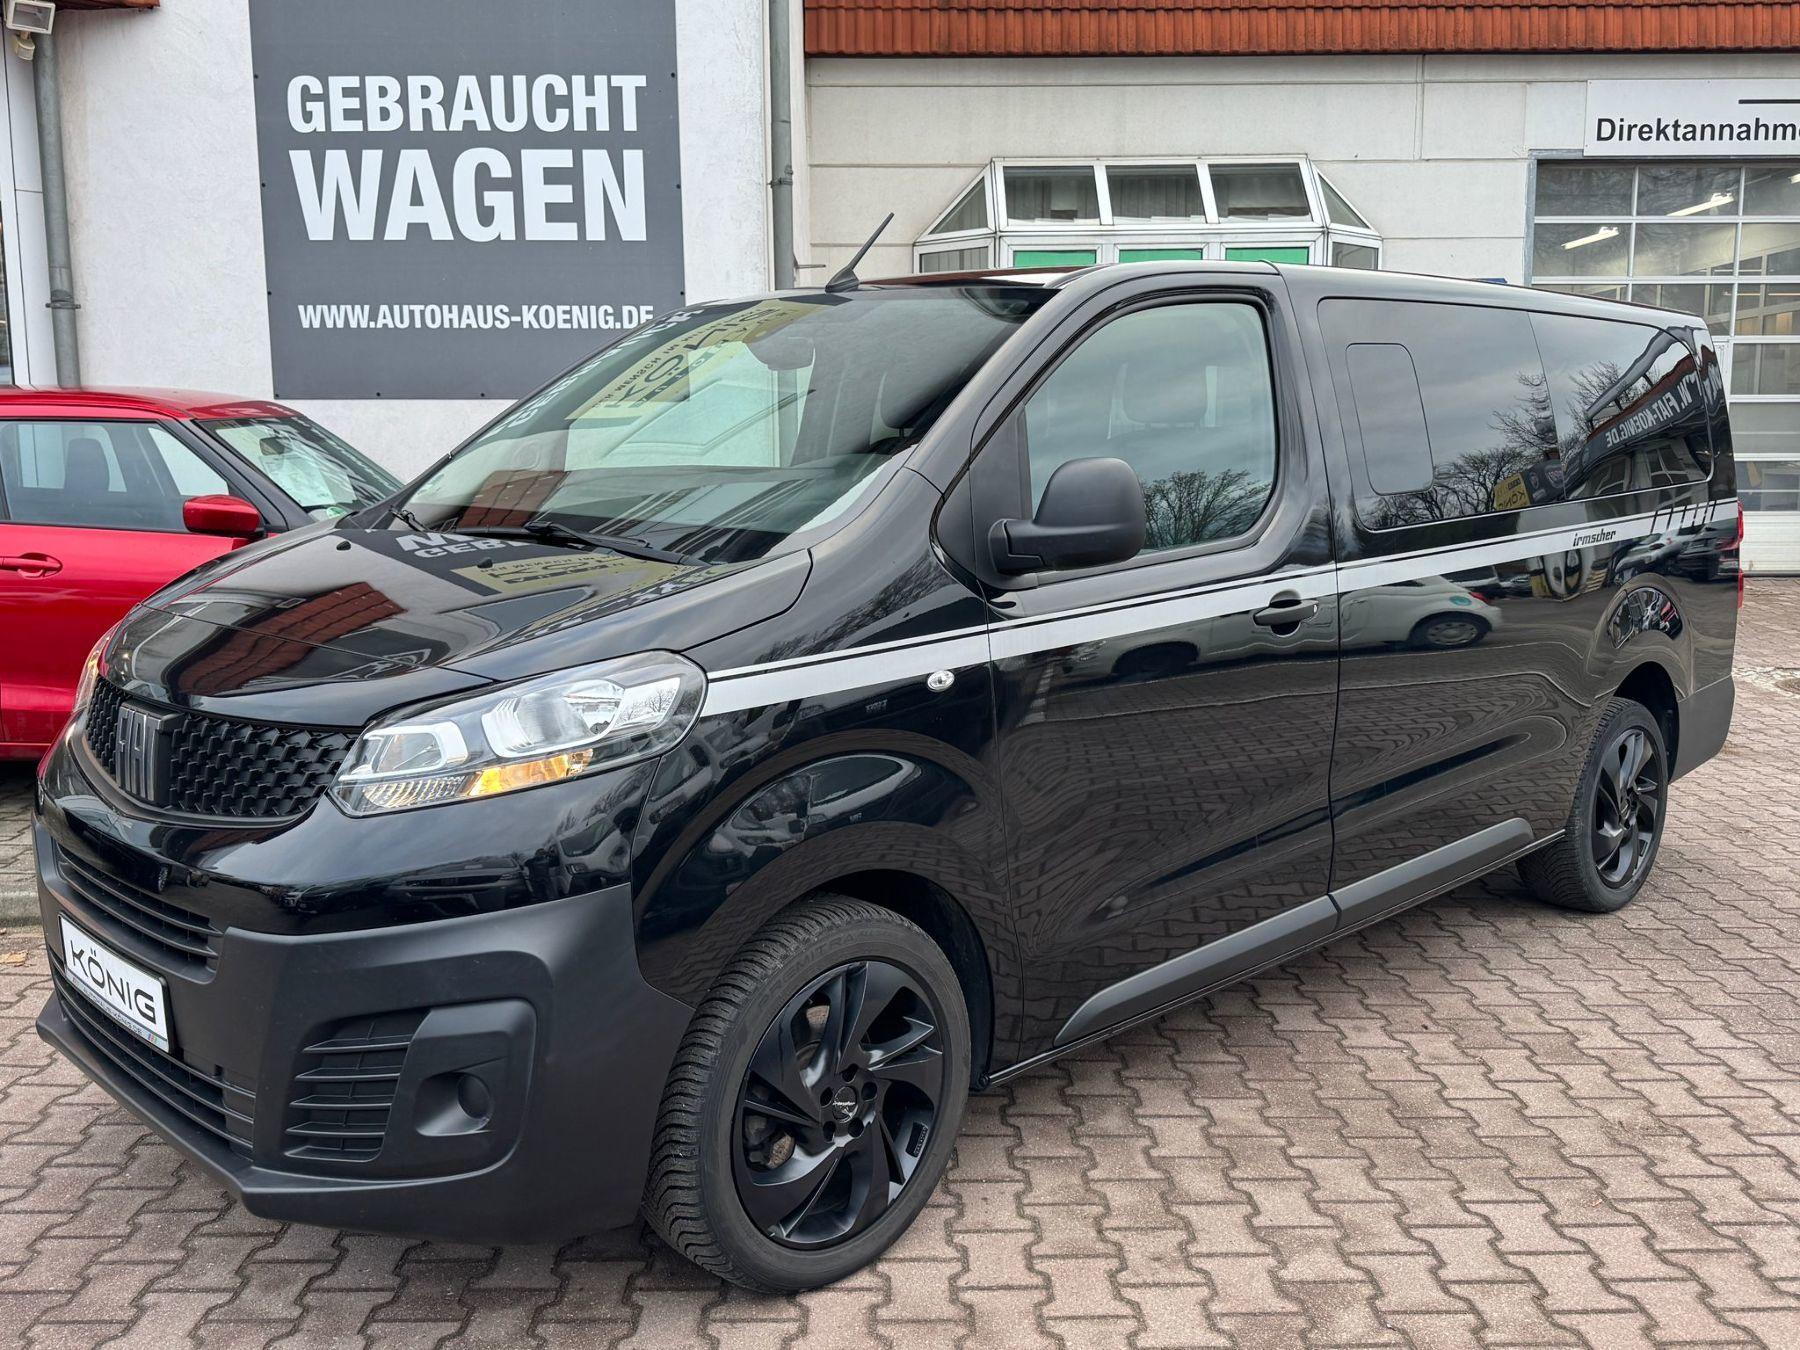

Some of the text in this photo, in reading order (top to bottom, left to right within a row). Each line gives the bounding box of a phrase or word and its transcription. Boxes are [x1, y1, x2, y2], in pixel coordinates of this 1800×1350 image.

[286, 74, 647, 133] GEBRAUCHT
[1596, 117, 1800, 142] Direktannahm
[288, 147, 648, 242] WAGEN
[297, 303, 655, 330] WWW.AUTOHAUS-KOENIG.DE
[1572, 529, 1617, 547] irmscher
[115, 706, 162, 801] FIAT
[69, 940, 157, 1025] KÖNIG
